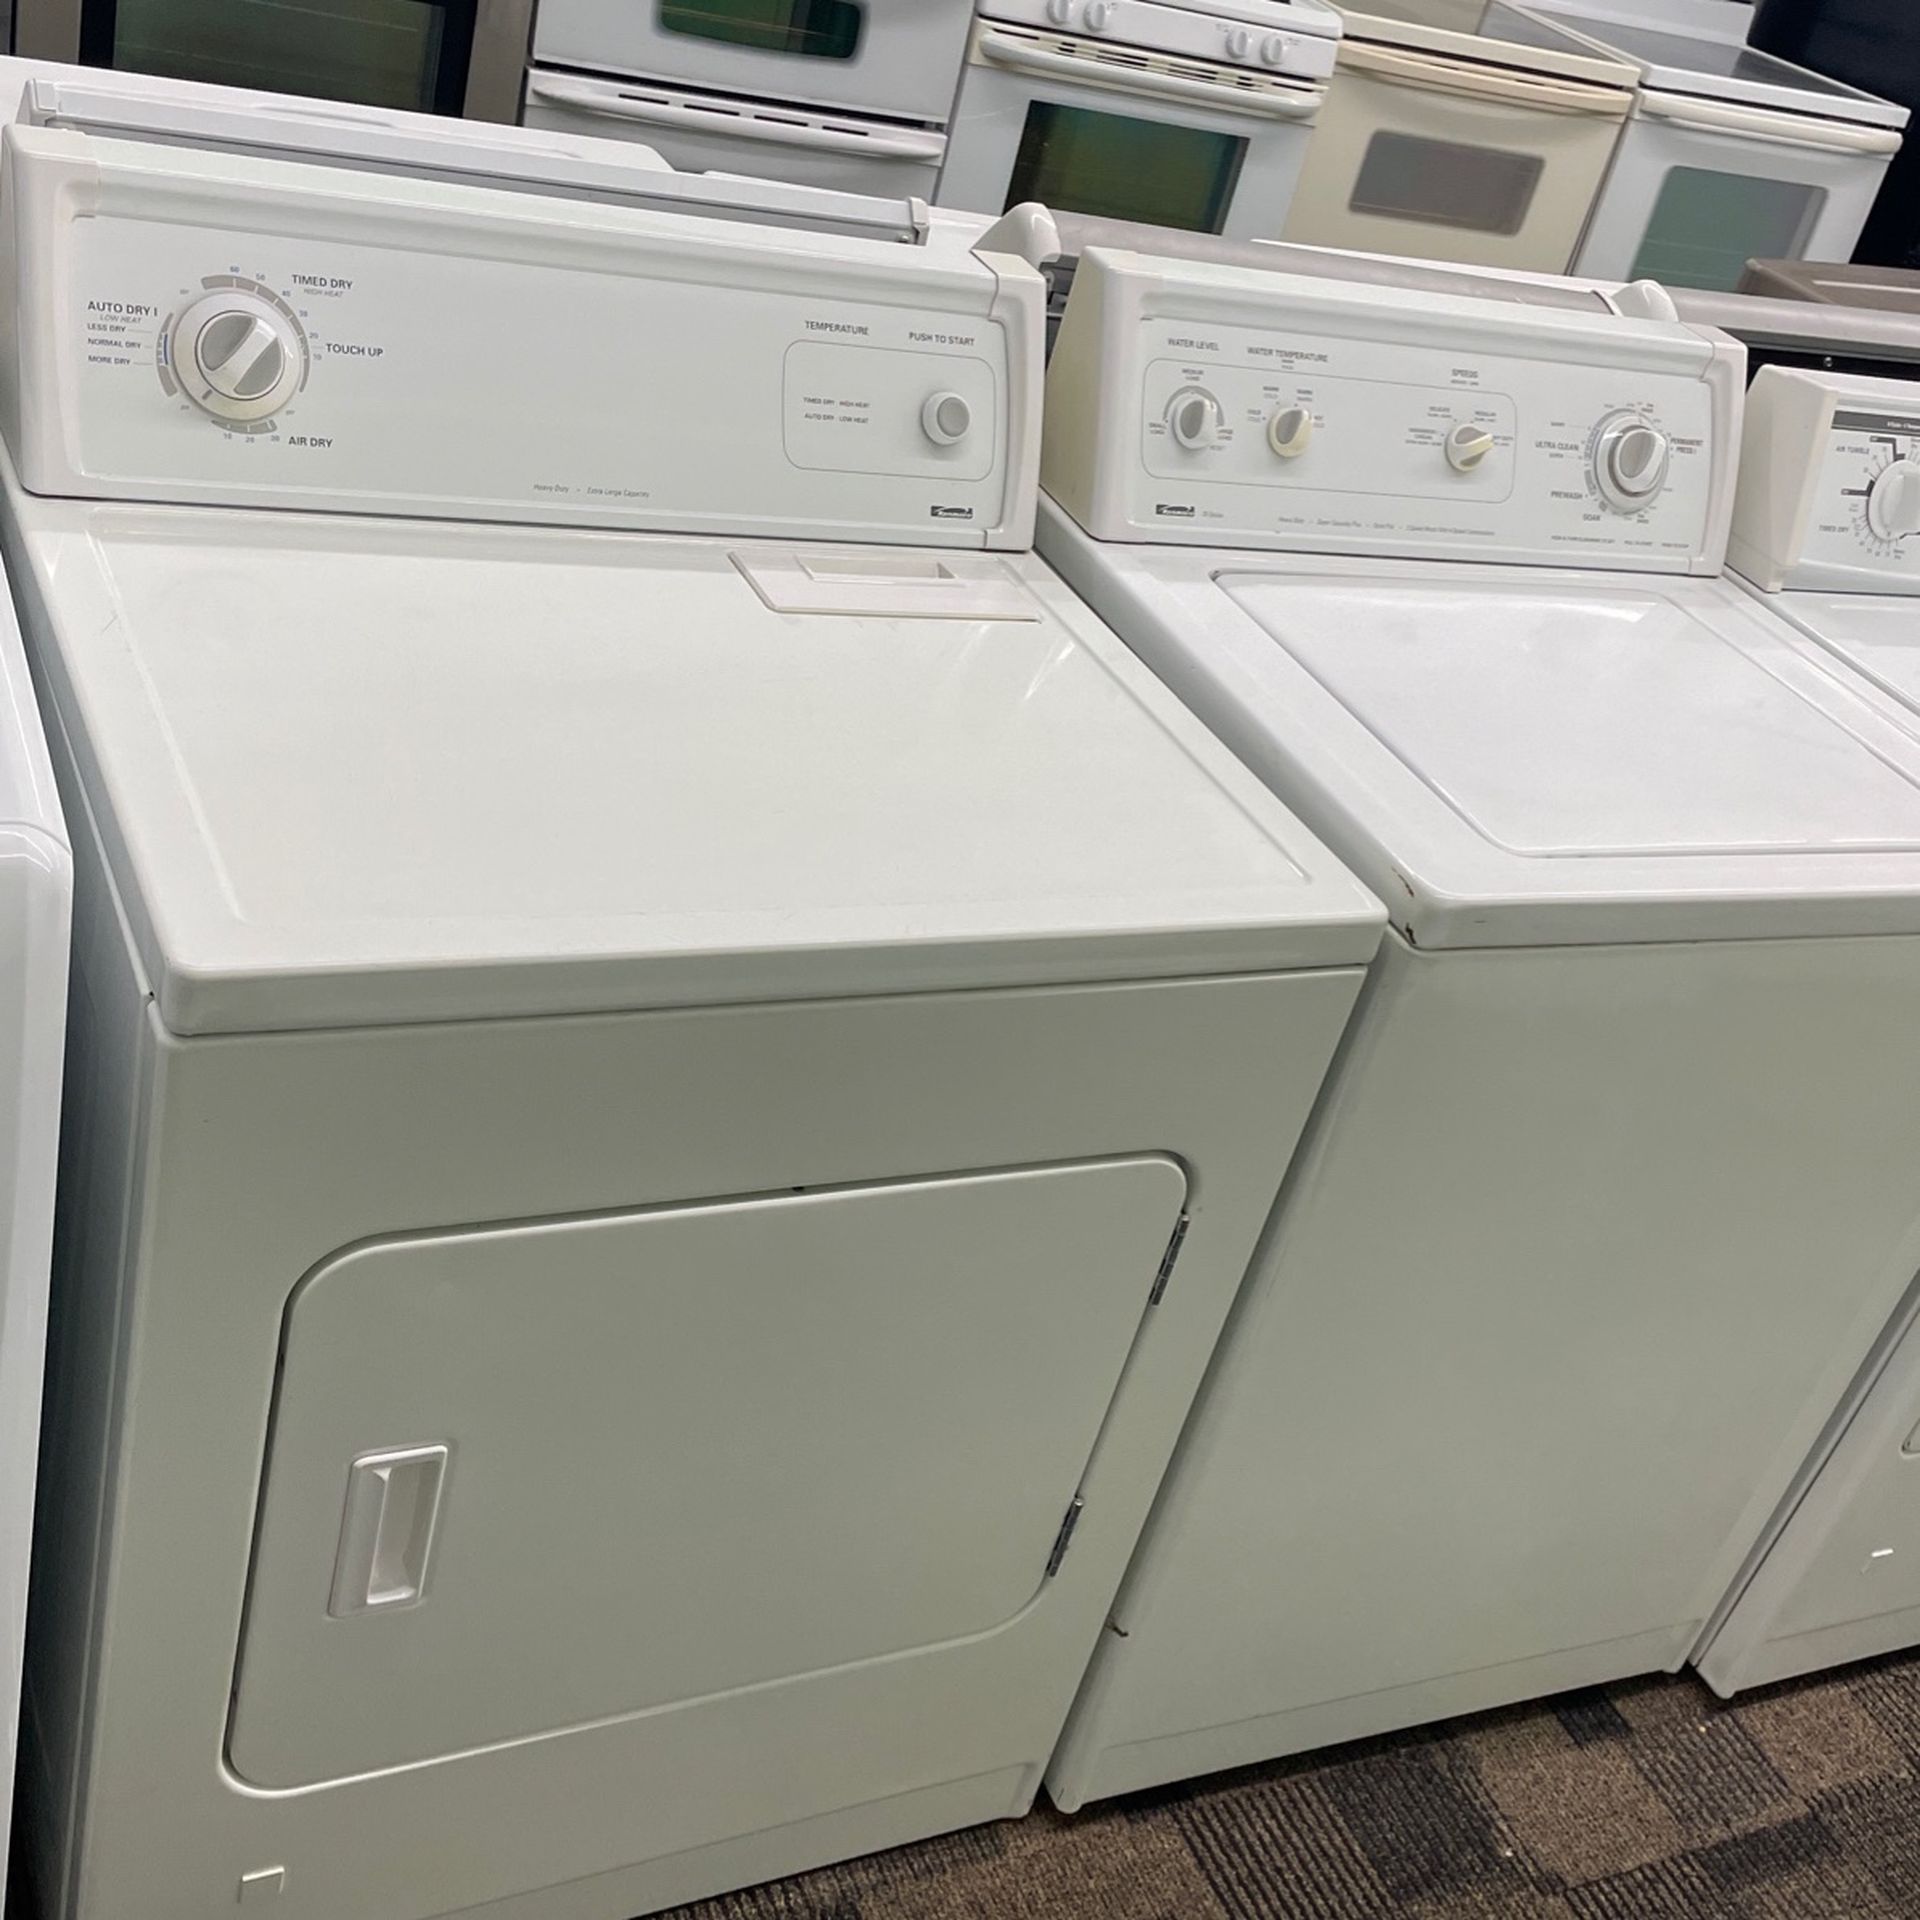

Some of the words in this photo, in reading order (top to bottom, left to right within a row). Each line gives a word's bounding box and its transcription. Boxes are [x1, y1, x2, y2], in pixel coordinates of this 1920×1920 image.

[292, 274, 327, 287] TIMED
[330, 279, 353, 290] DRY
[303, 288, 323, 296] HIGH
[88, 301, 123, 313] AUTO
[126, 304, 151, 316] DRY
[100, 314, 120, 322] LOW
[120, 316, 142, 324] HEAT
[87, 323, 108, 331] LESS
[109, 325, 126, 333] DRY
[804, 320, 869, 336] TEMPERATURE
[88, 337, 123, 348] NORMAL
[125, 341, 141, 349] DRY
[908, 331, 933, 342] PUSH
[934, 334, 947, 344] TO
[948, 335, 975, 347] START
[1168, 338, 1195, 348] WATER
[1195, 341, 1219, 351] LEVEL
[326, 343, 365, 356] TOUCH
[367, 347, 384, 357] UP
[1247, 347, 1274, 357] WATER
[1275, 349, 1328, 363] TEMPERATURE
[88, 355, 112, 364] MORE
[114, 357, 130, 365] DRY
[803, 396, 822, 405] TIMED
[823, 398, 835, 406] DRY
[804, 412, 822, 420] AUTO
[839, 415, 853, 423] LOW
[853, 416, 869, 424] HEAT
[288, 436, 307, 446] AIR
[309, 437, 333, 448] DRY
[1535, 441, 1557, 450] ULTRA
[1557, 443, 1579, 451] CLEAN
